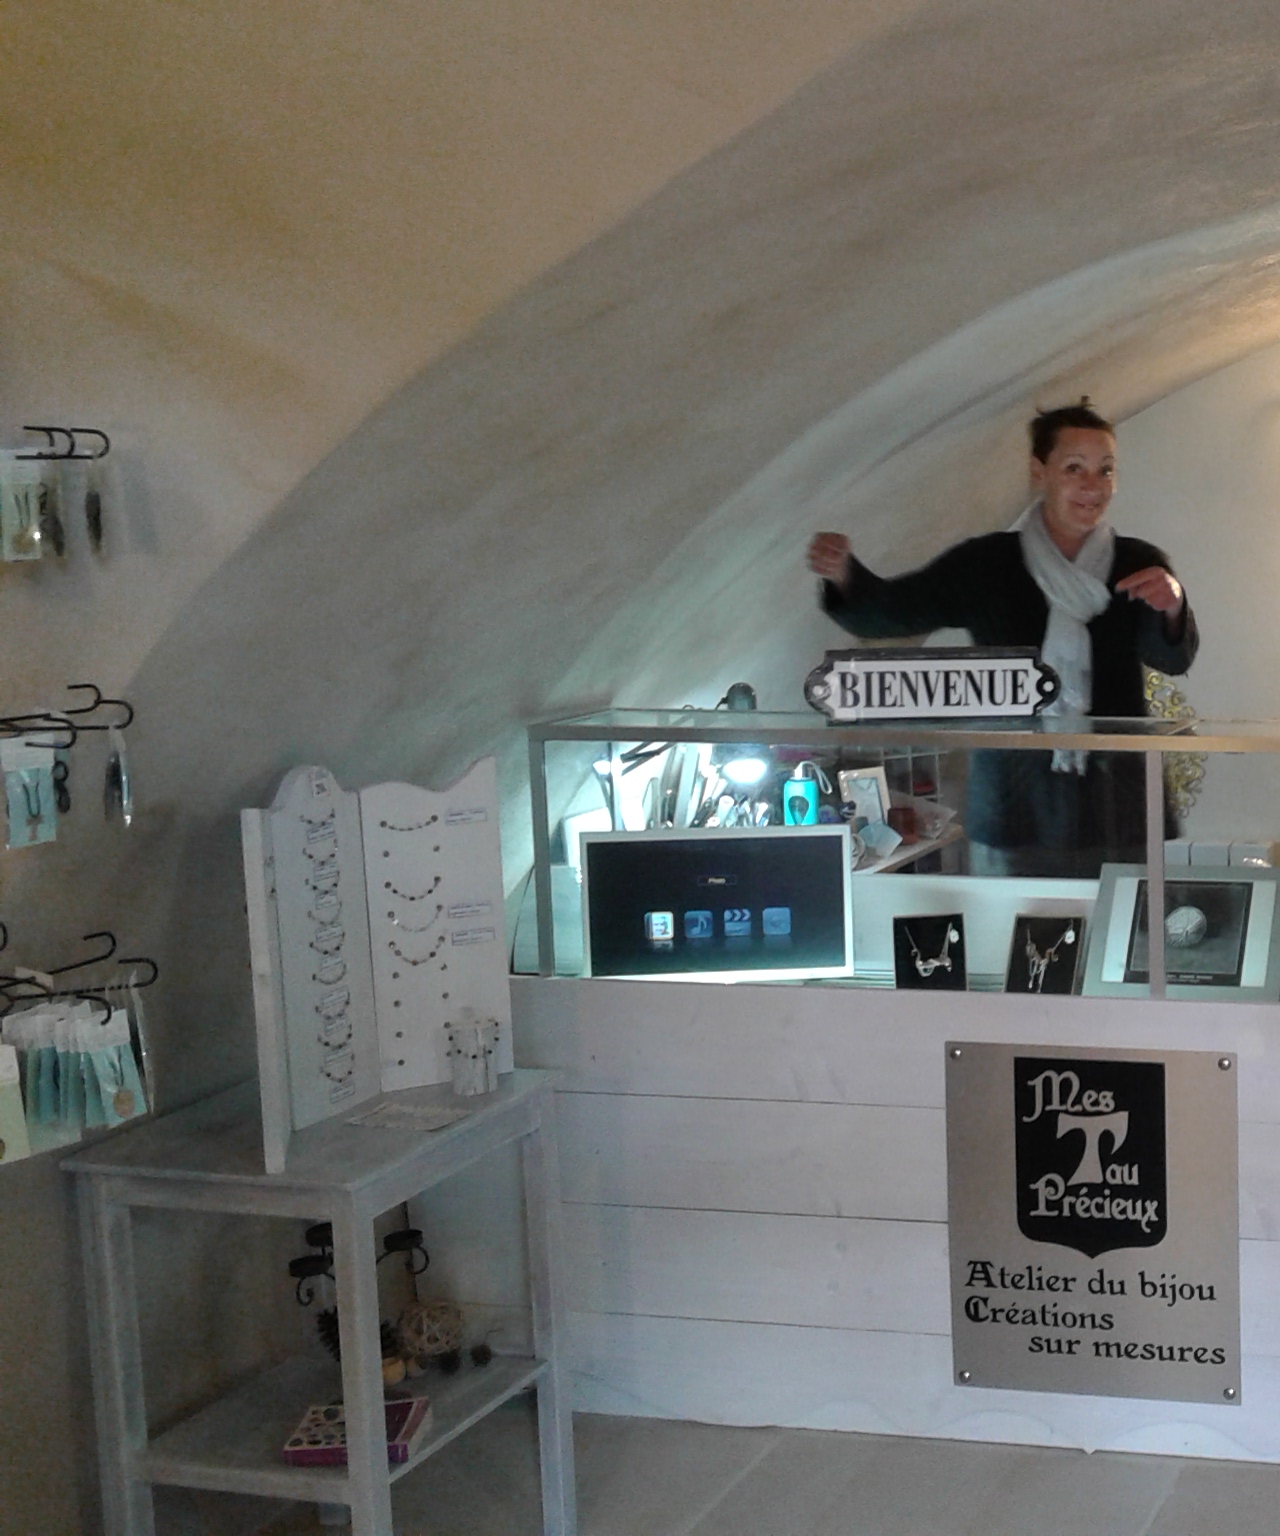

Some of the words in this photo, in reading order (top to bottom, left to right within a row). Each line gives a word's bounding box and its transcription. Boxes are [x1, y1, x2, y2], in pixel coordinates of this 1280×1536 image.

[837, 669, 1030, 708] BIENVENUE
[1022, 1069, 1116, 1122] Mes
[1029, 1173, 1159, 1233] Précieux
[964, 1260, 1077, 1293] Atelier
[1087, 1269, 1127, 1297] du
[1139, 1271, 1216, 1306] bijou
[964, 1295, 1115, 1331] Créations
[1028, 1334, 1081, 1356] sur
[1092, 1340, 1227, 1366] mesures
